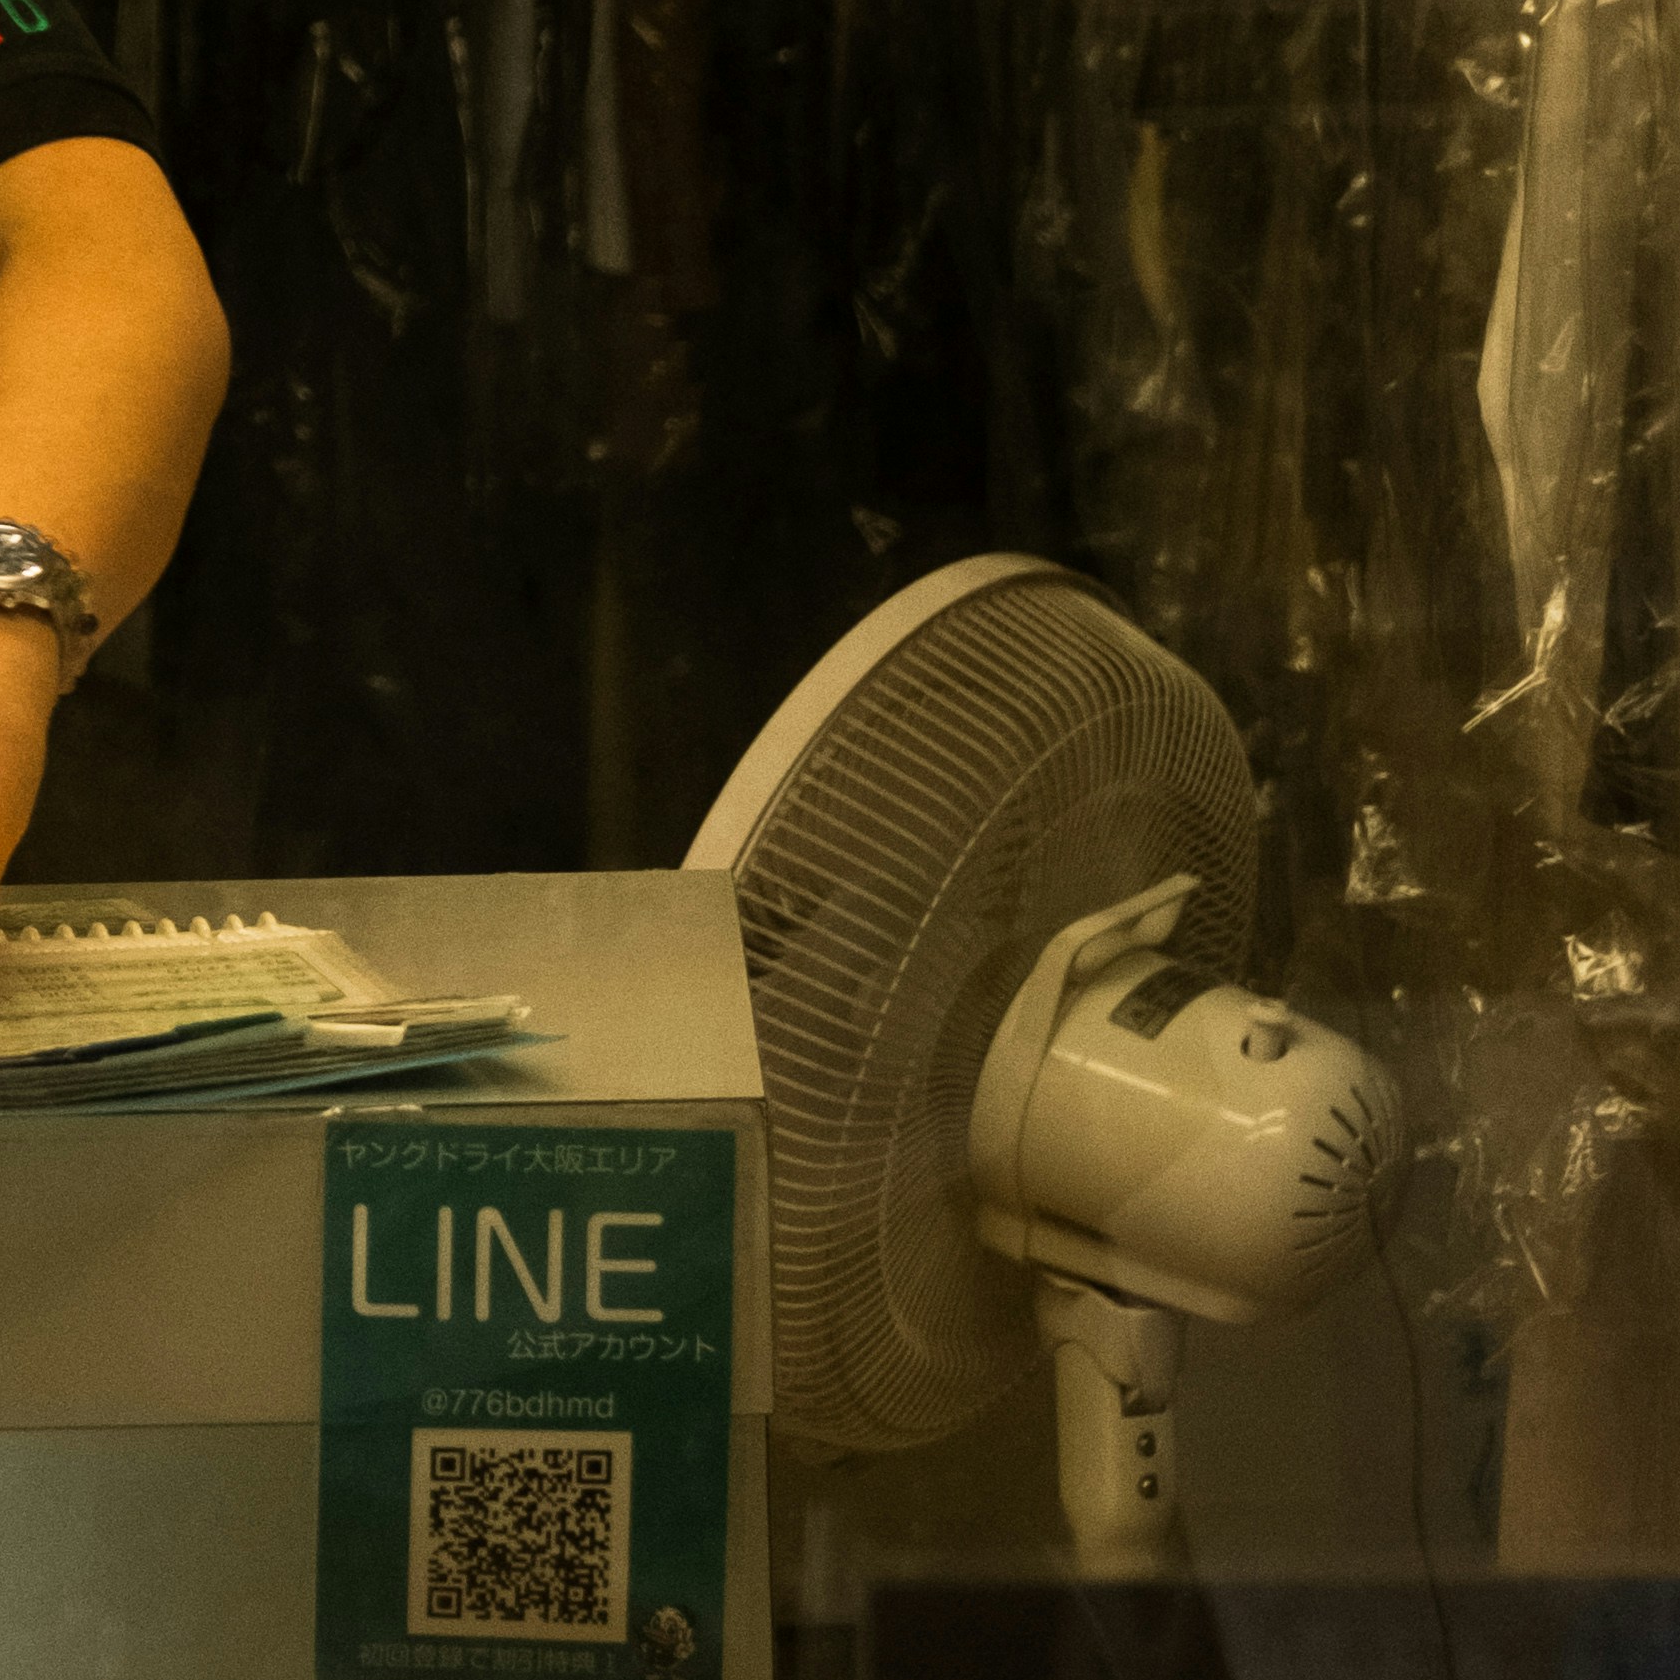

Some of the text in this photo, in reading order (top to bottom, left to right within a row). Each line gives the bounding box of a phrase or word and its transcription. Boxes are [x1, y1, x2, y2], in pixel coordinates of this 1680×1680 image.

[338, 1139, 677, 1175] ヤングドライ大阪エリア
[351, 1203, 665, 1324] LINE
[507, 1331, 718, 1364] 公式アカウント
[422, 1389, 615, 1419] @776bdhmd
